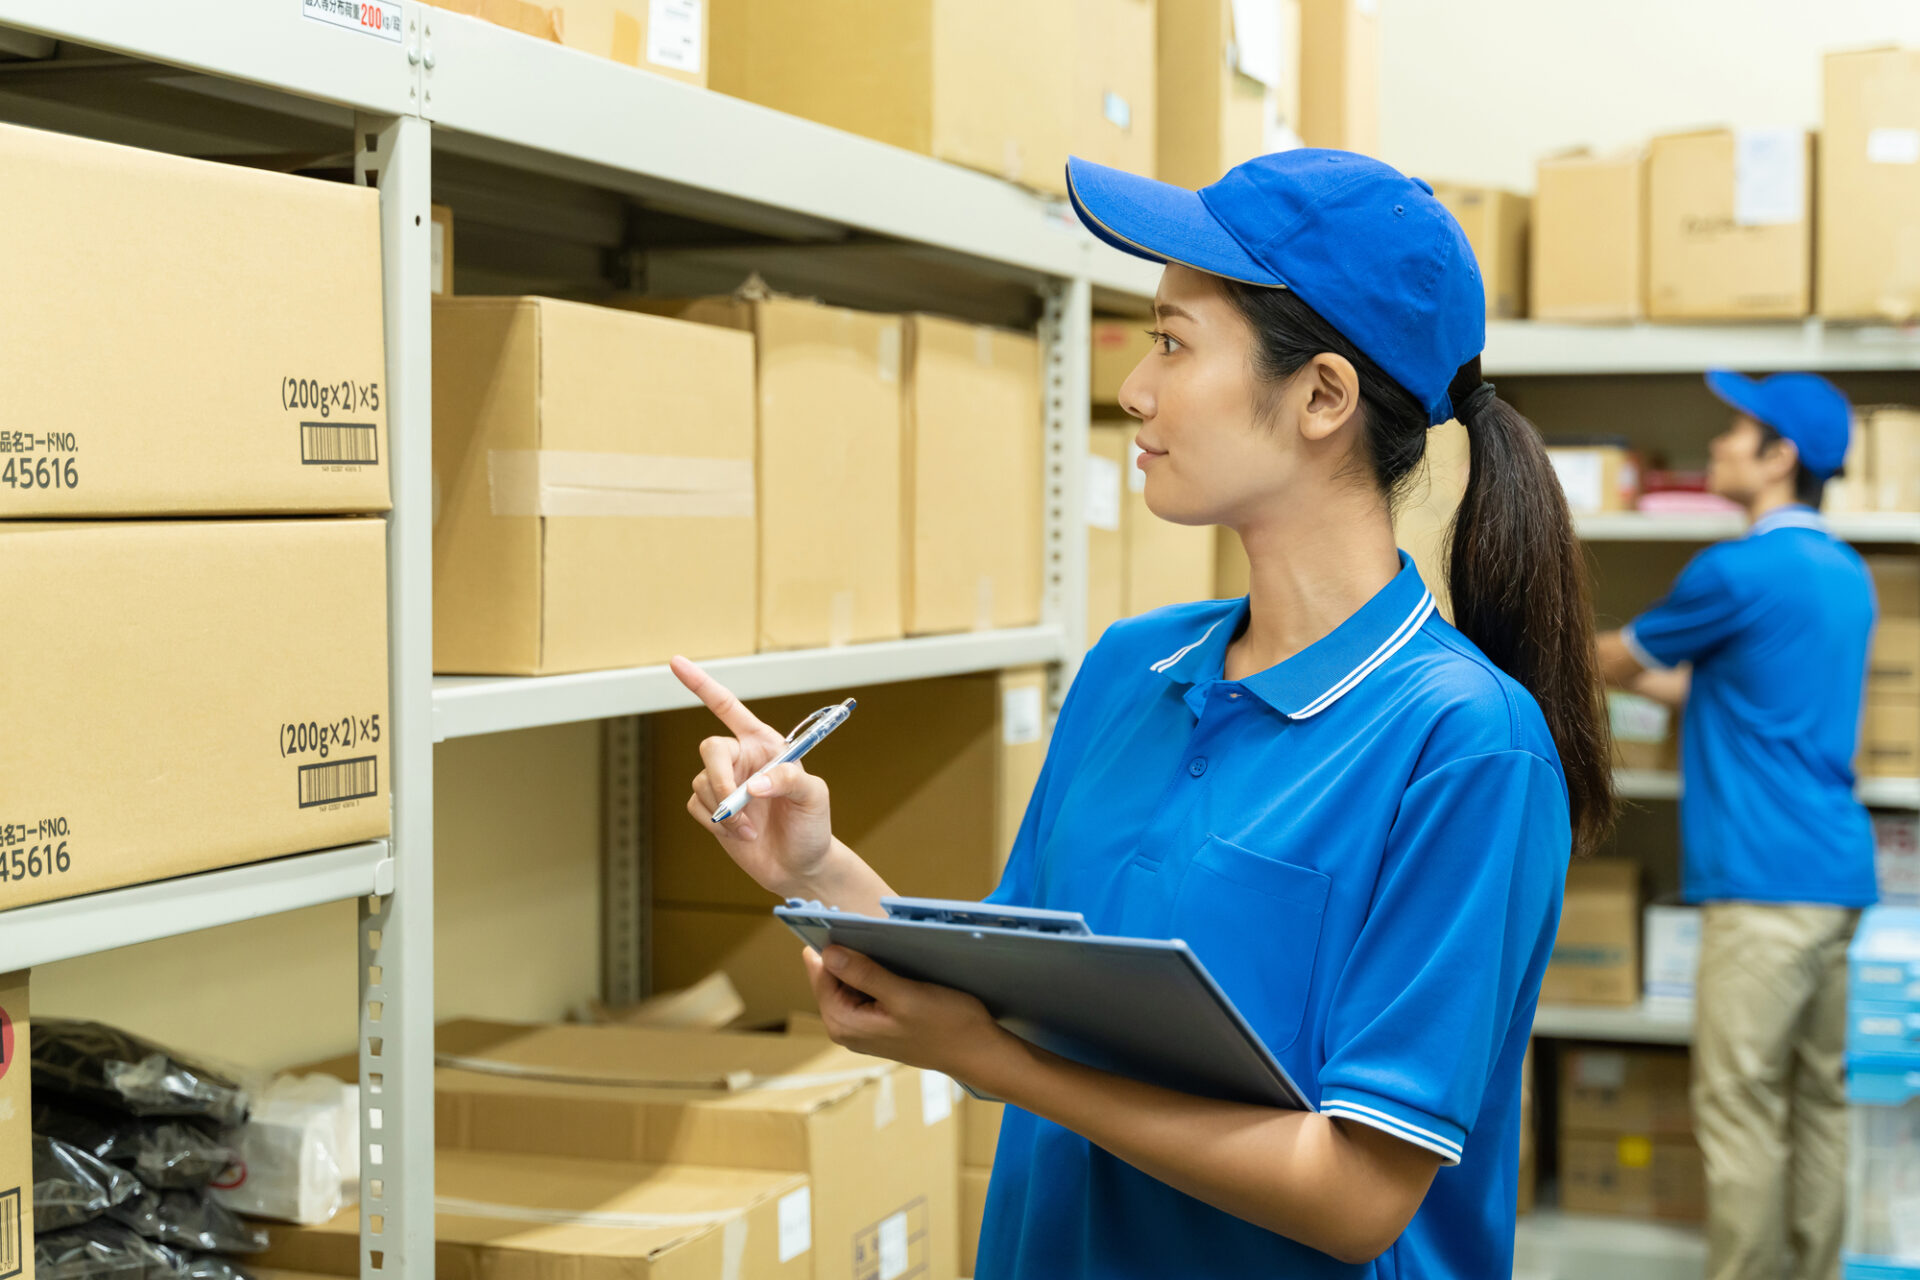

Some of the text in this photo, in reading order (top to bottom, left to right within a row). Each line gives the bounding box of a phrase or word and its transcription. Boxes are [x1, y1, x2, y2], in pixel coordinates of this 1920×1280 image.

[282, 376, 379, 418] (200g×2)×5
[0, 431, 78, 453] 品名コードNO.
[2, 457, 79, 489] 45616
[280, 714, 380, 758] (200g×2)×5
[0, 841, 71, 882] 45616
